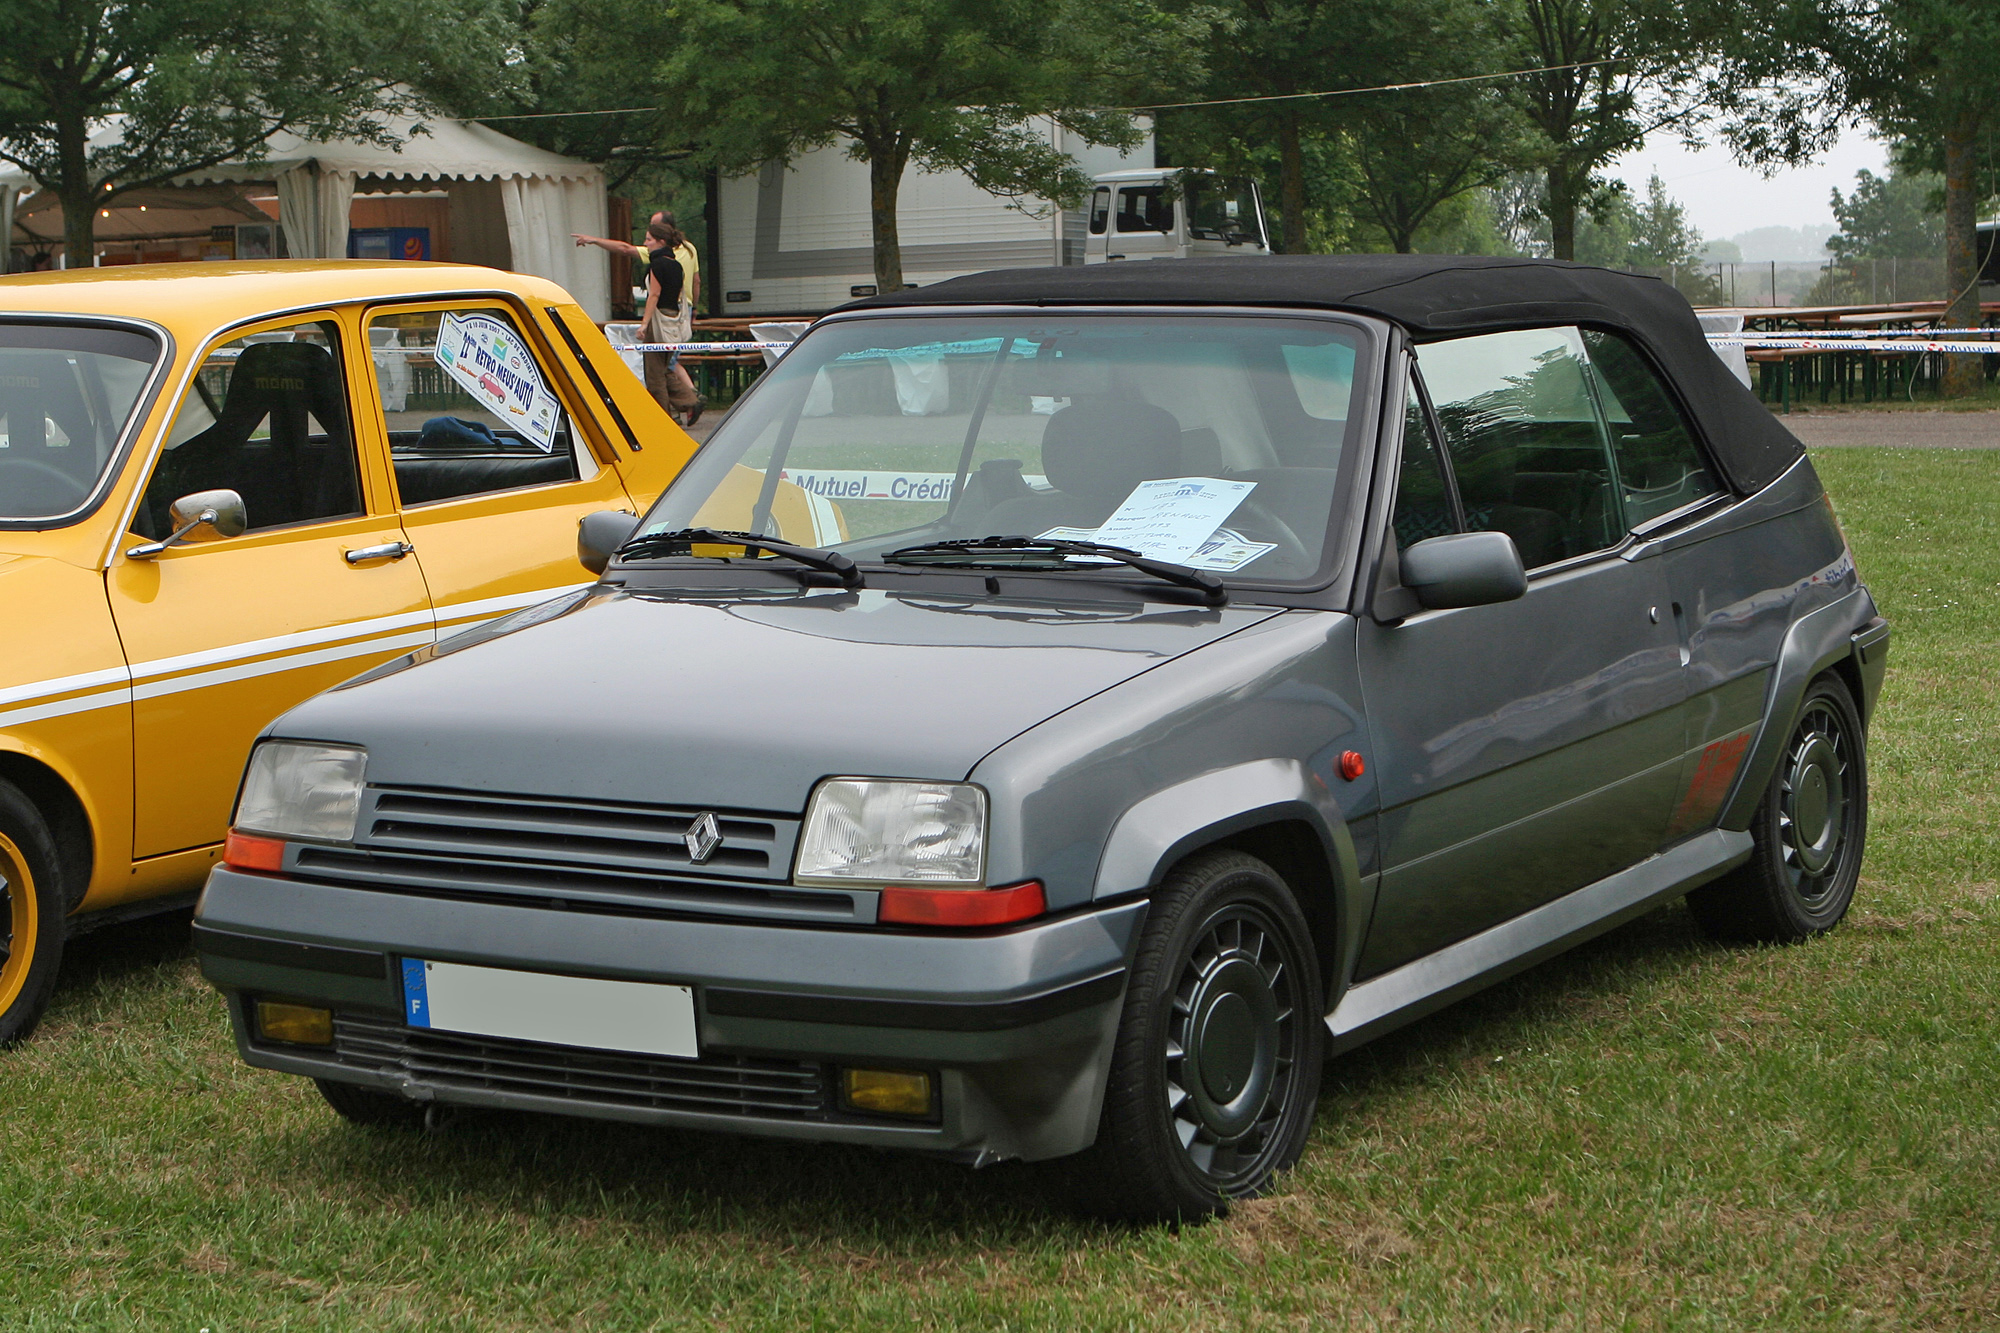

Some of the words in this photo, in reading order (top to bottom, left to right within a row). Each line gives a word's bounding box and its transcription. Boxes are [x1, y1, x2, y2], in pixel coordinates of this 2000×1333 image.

[505, 334, 515, 345] LAC
[1818, 341, 1868, 350] Mutuel
[1881, 343, 1926, 352] Crédit
[1943, 344, 1995, 353] Mutuel
[475, 345, 497, 374] RETRO
[796, 475, 868, 498] Mutuel
[1151, 511, 1211, 520] RENAULT
[1697, 741, 1721, 771] GT
[411, 999, 421, 1015] F
